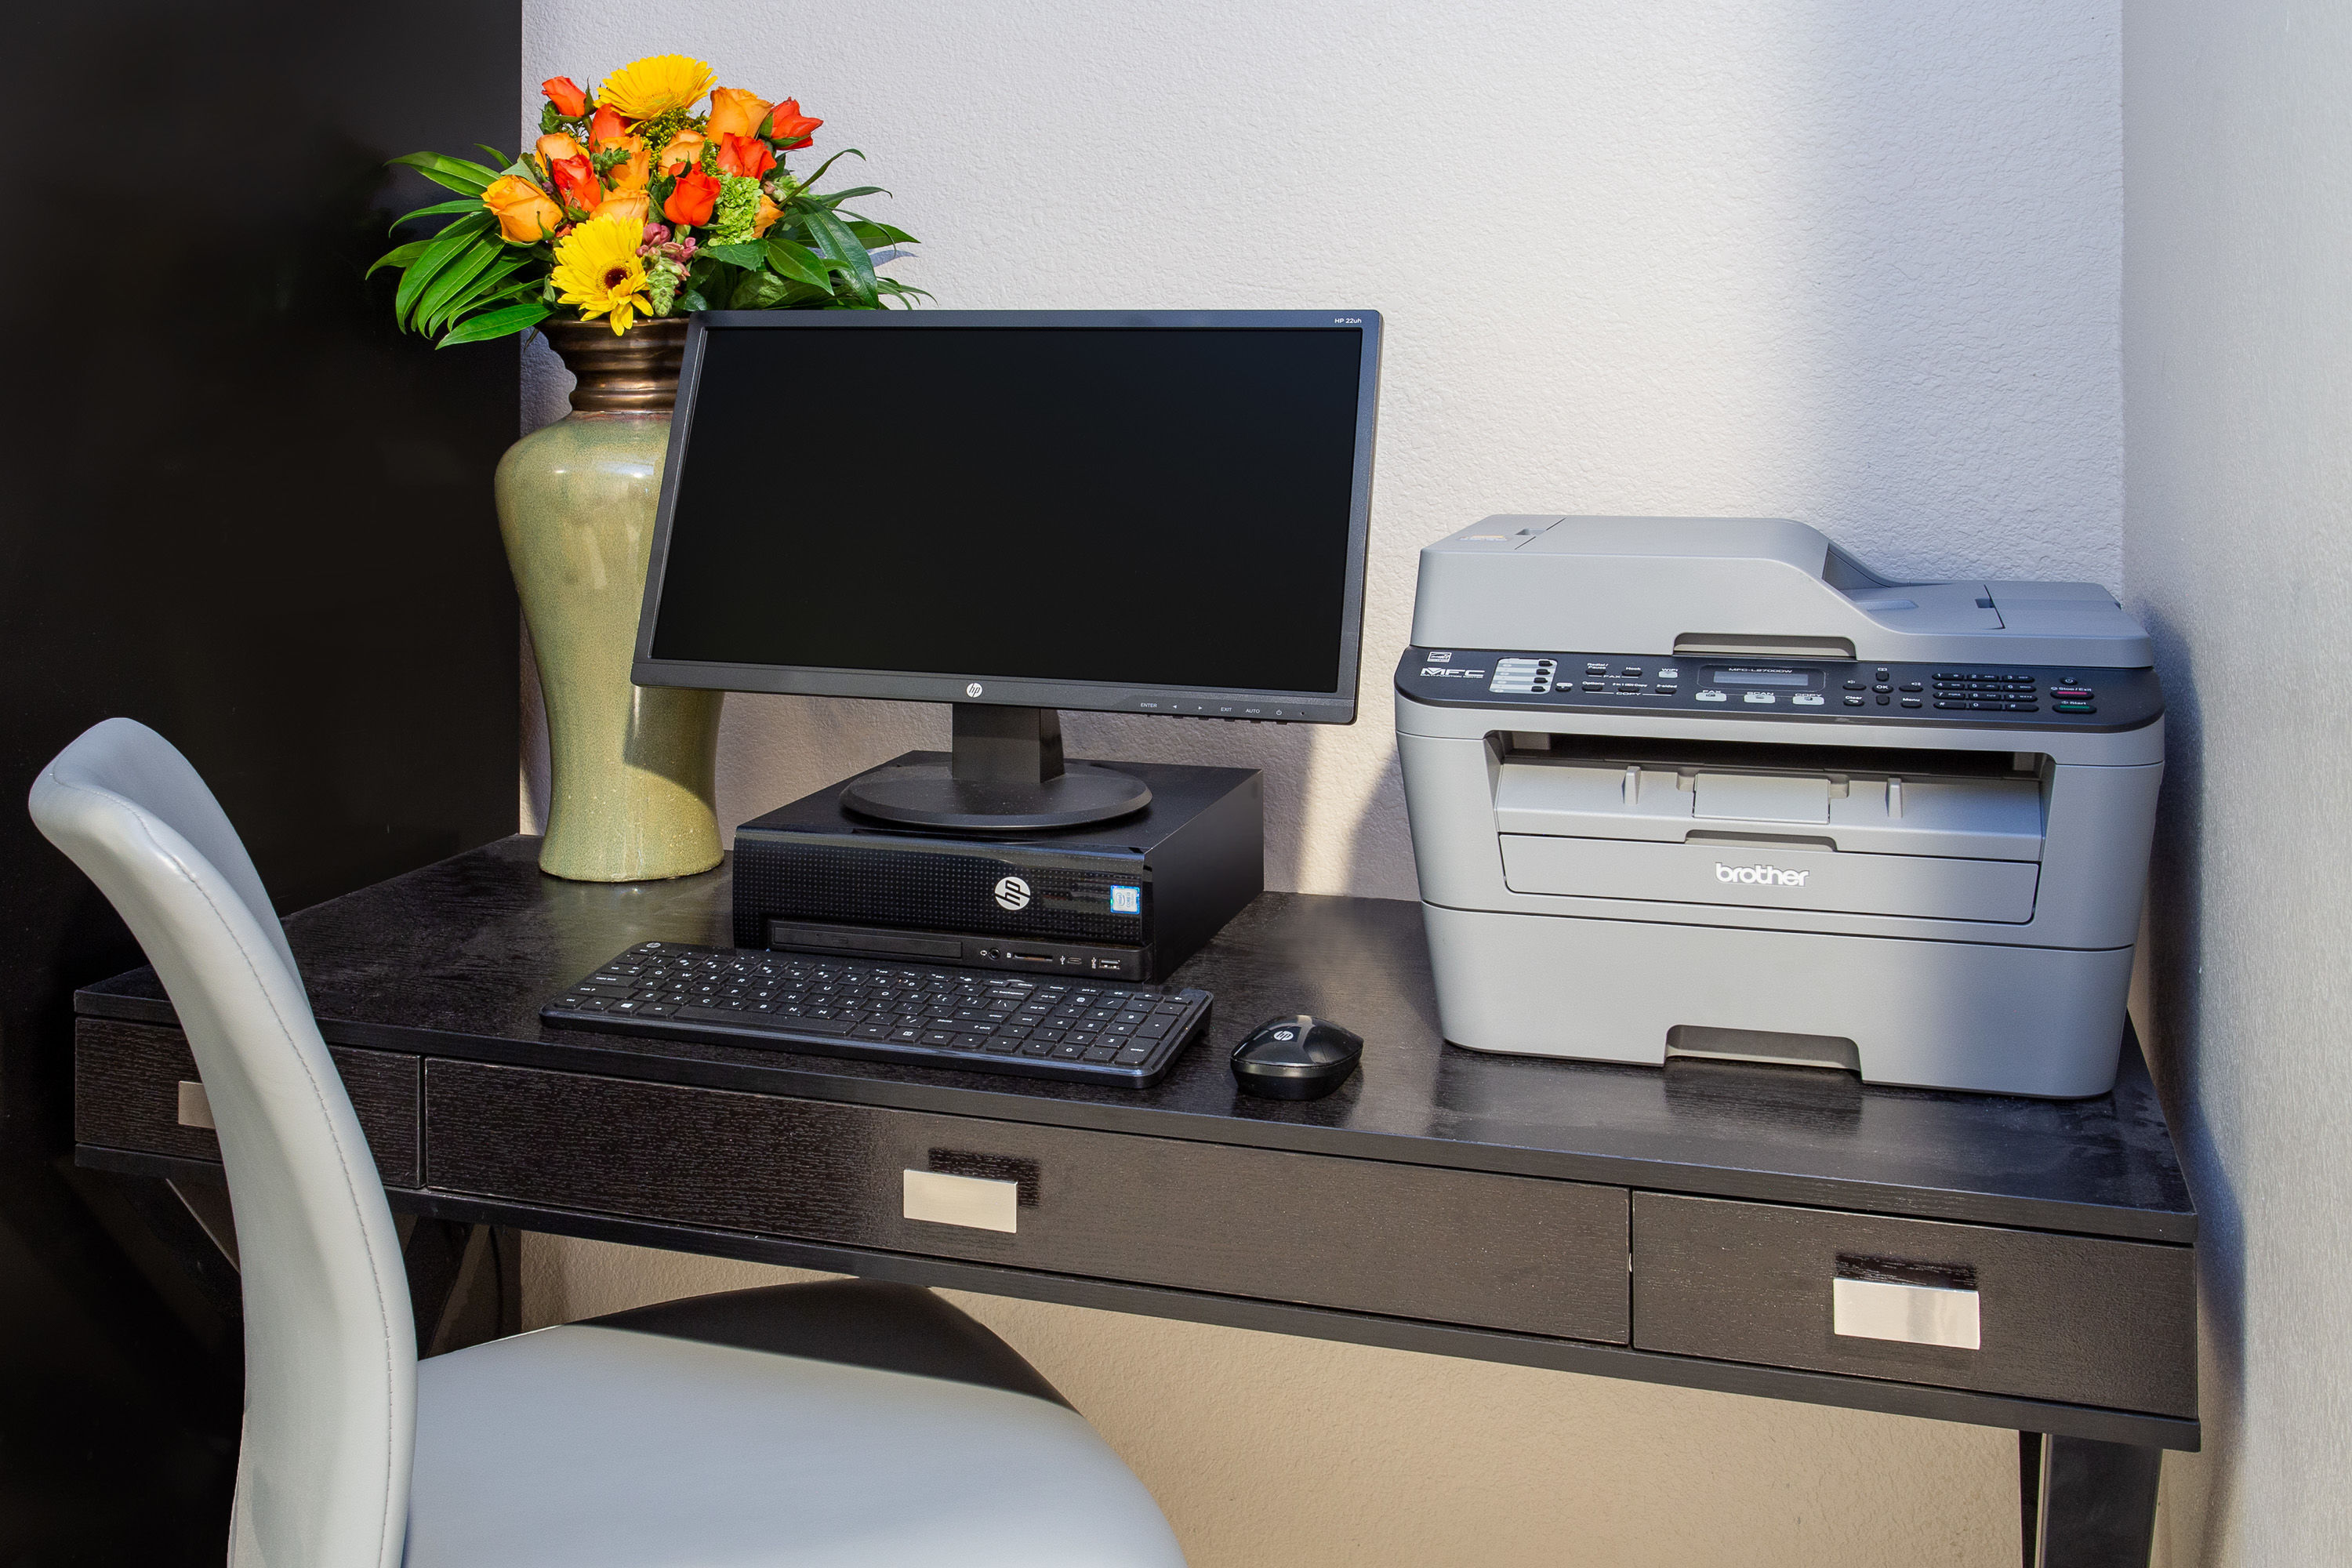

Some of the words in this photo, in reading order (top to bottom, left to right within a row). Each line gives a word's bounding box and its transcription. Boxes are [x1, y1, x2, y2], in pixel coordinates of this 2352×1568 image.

[1420, 667, 1485, 676] MFC
[1715, 862, 1809, 887] brother
[995, 878, 1030, 909] hp
[1275, 1031, 1293, 1040] hp
